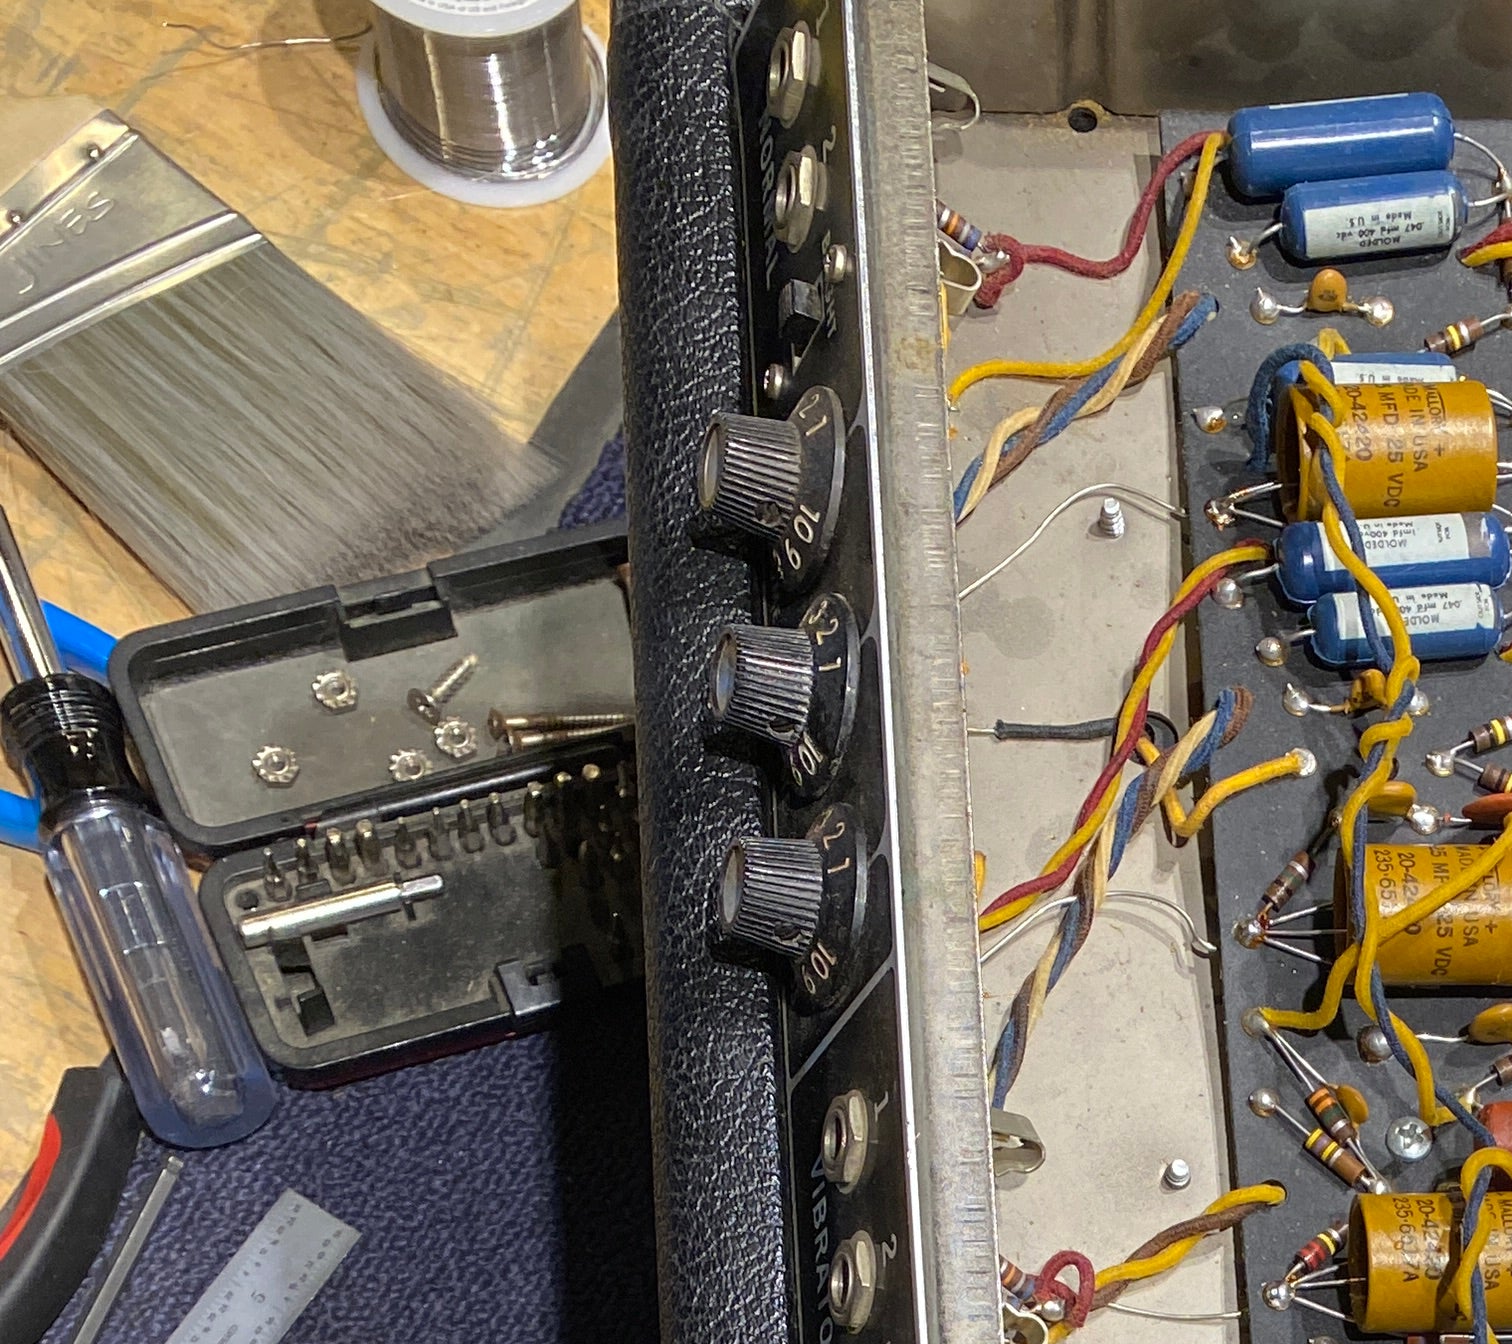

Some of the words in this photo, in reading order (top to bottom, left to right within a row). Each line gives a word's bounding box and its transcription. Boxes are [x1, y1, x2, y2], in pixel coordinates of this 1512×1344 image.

[1359, 236, 1401, 247] MOLDED
[1411, 435, 1428, 472] USA
[1384, 473, 1403, 508] VDC
[1404, 614, 1439, 626] MOLDE
[1463, 913, 1479, 947] USA
[1431, 948, 1452, 976] VDC
[880, 1233, 897, 1267] 2
[1484, 1256, 1500, 1290] USA
